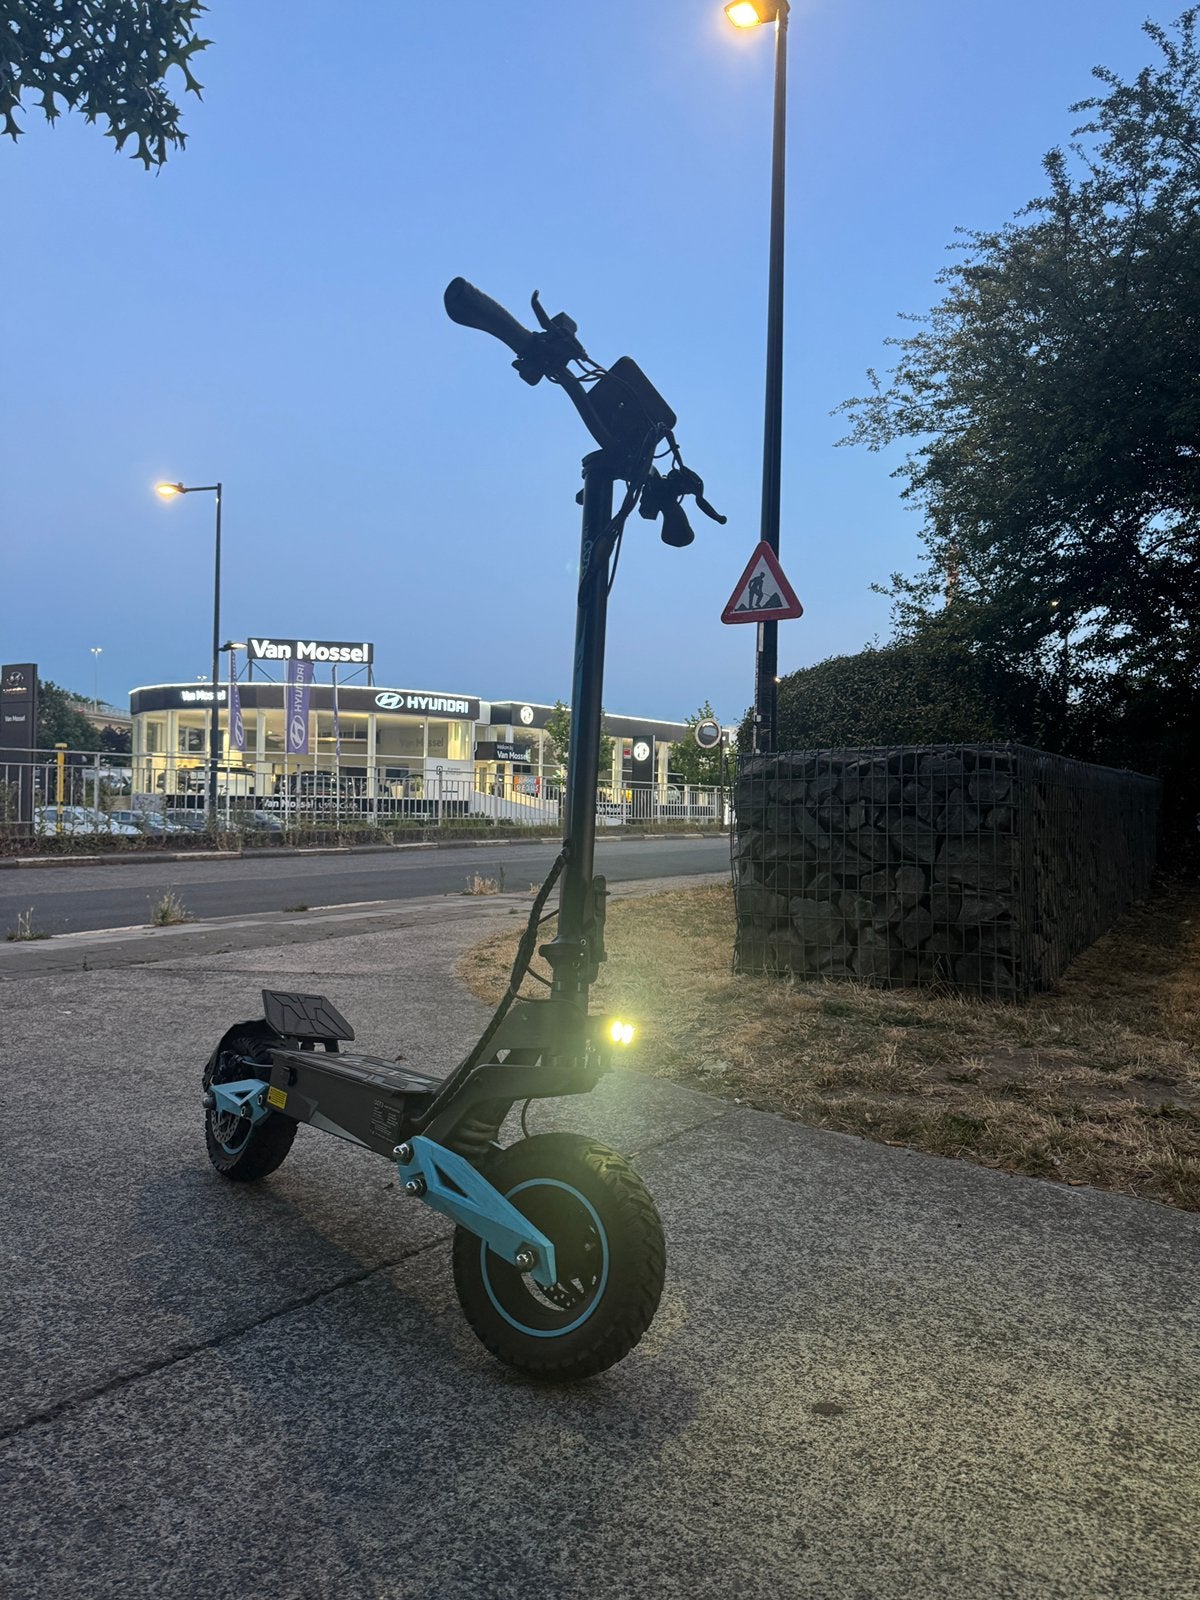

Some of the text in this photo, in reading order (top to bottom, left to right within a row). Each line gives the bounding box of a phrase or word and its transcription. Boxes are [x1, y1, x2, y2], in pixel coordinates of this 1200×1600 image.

[251, 639, 369, 662] Van Mossel
[294, 663, 305, 712] HYUNDAI
[181, 690, 226, 701] Van Mosel
[407, 696, 469, 714] HYUNDAI
[497, 751, 508, 759] Van
[261, 799, 279, 808] Van
